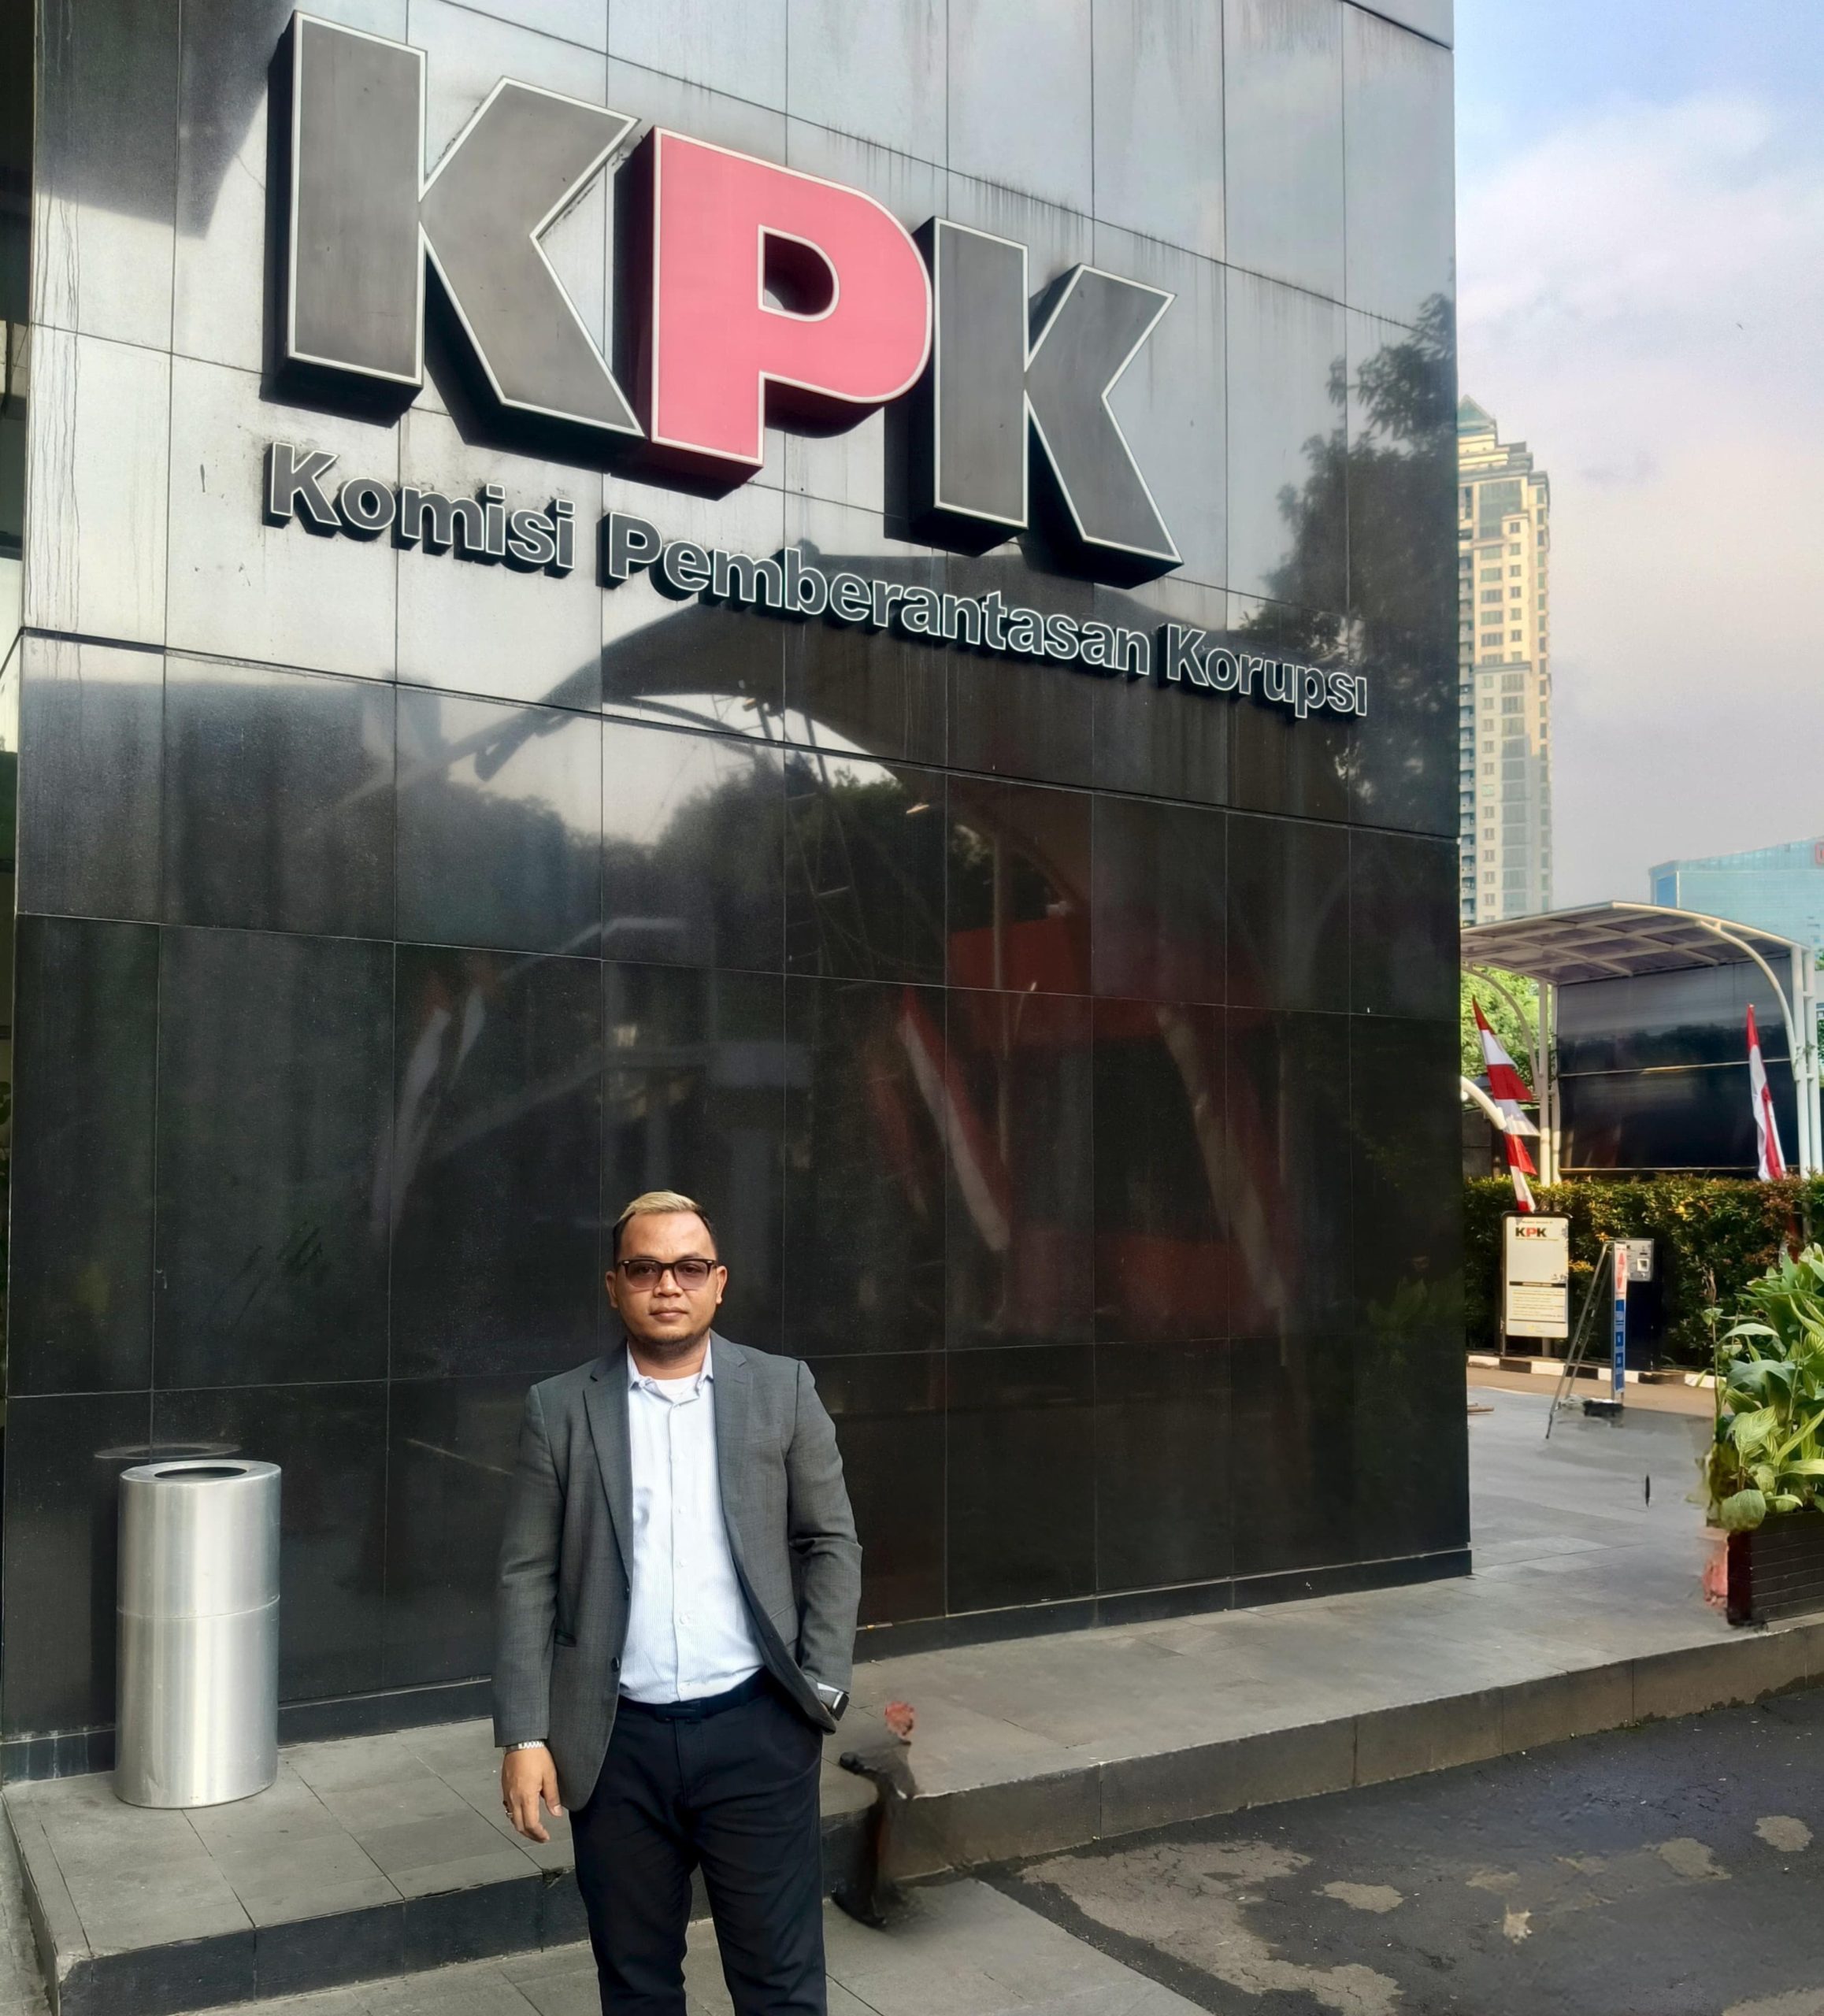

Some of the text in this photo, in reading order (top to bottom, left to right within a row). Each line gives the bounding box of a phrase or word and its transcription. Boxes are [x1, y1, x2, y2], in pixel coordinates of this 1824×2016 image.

[287, 10, 1183, 565] KPK
[269, 441, 1368, 719] Komisi Pemberantasan Korupsi
[1515, 1227, 1547, 1237] KPK
